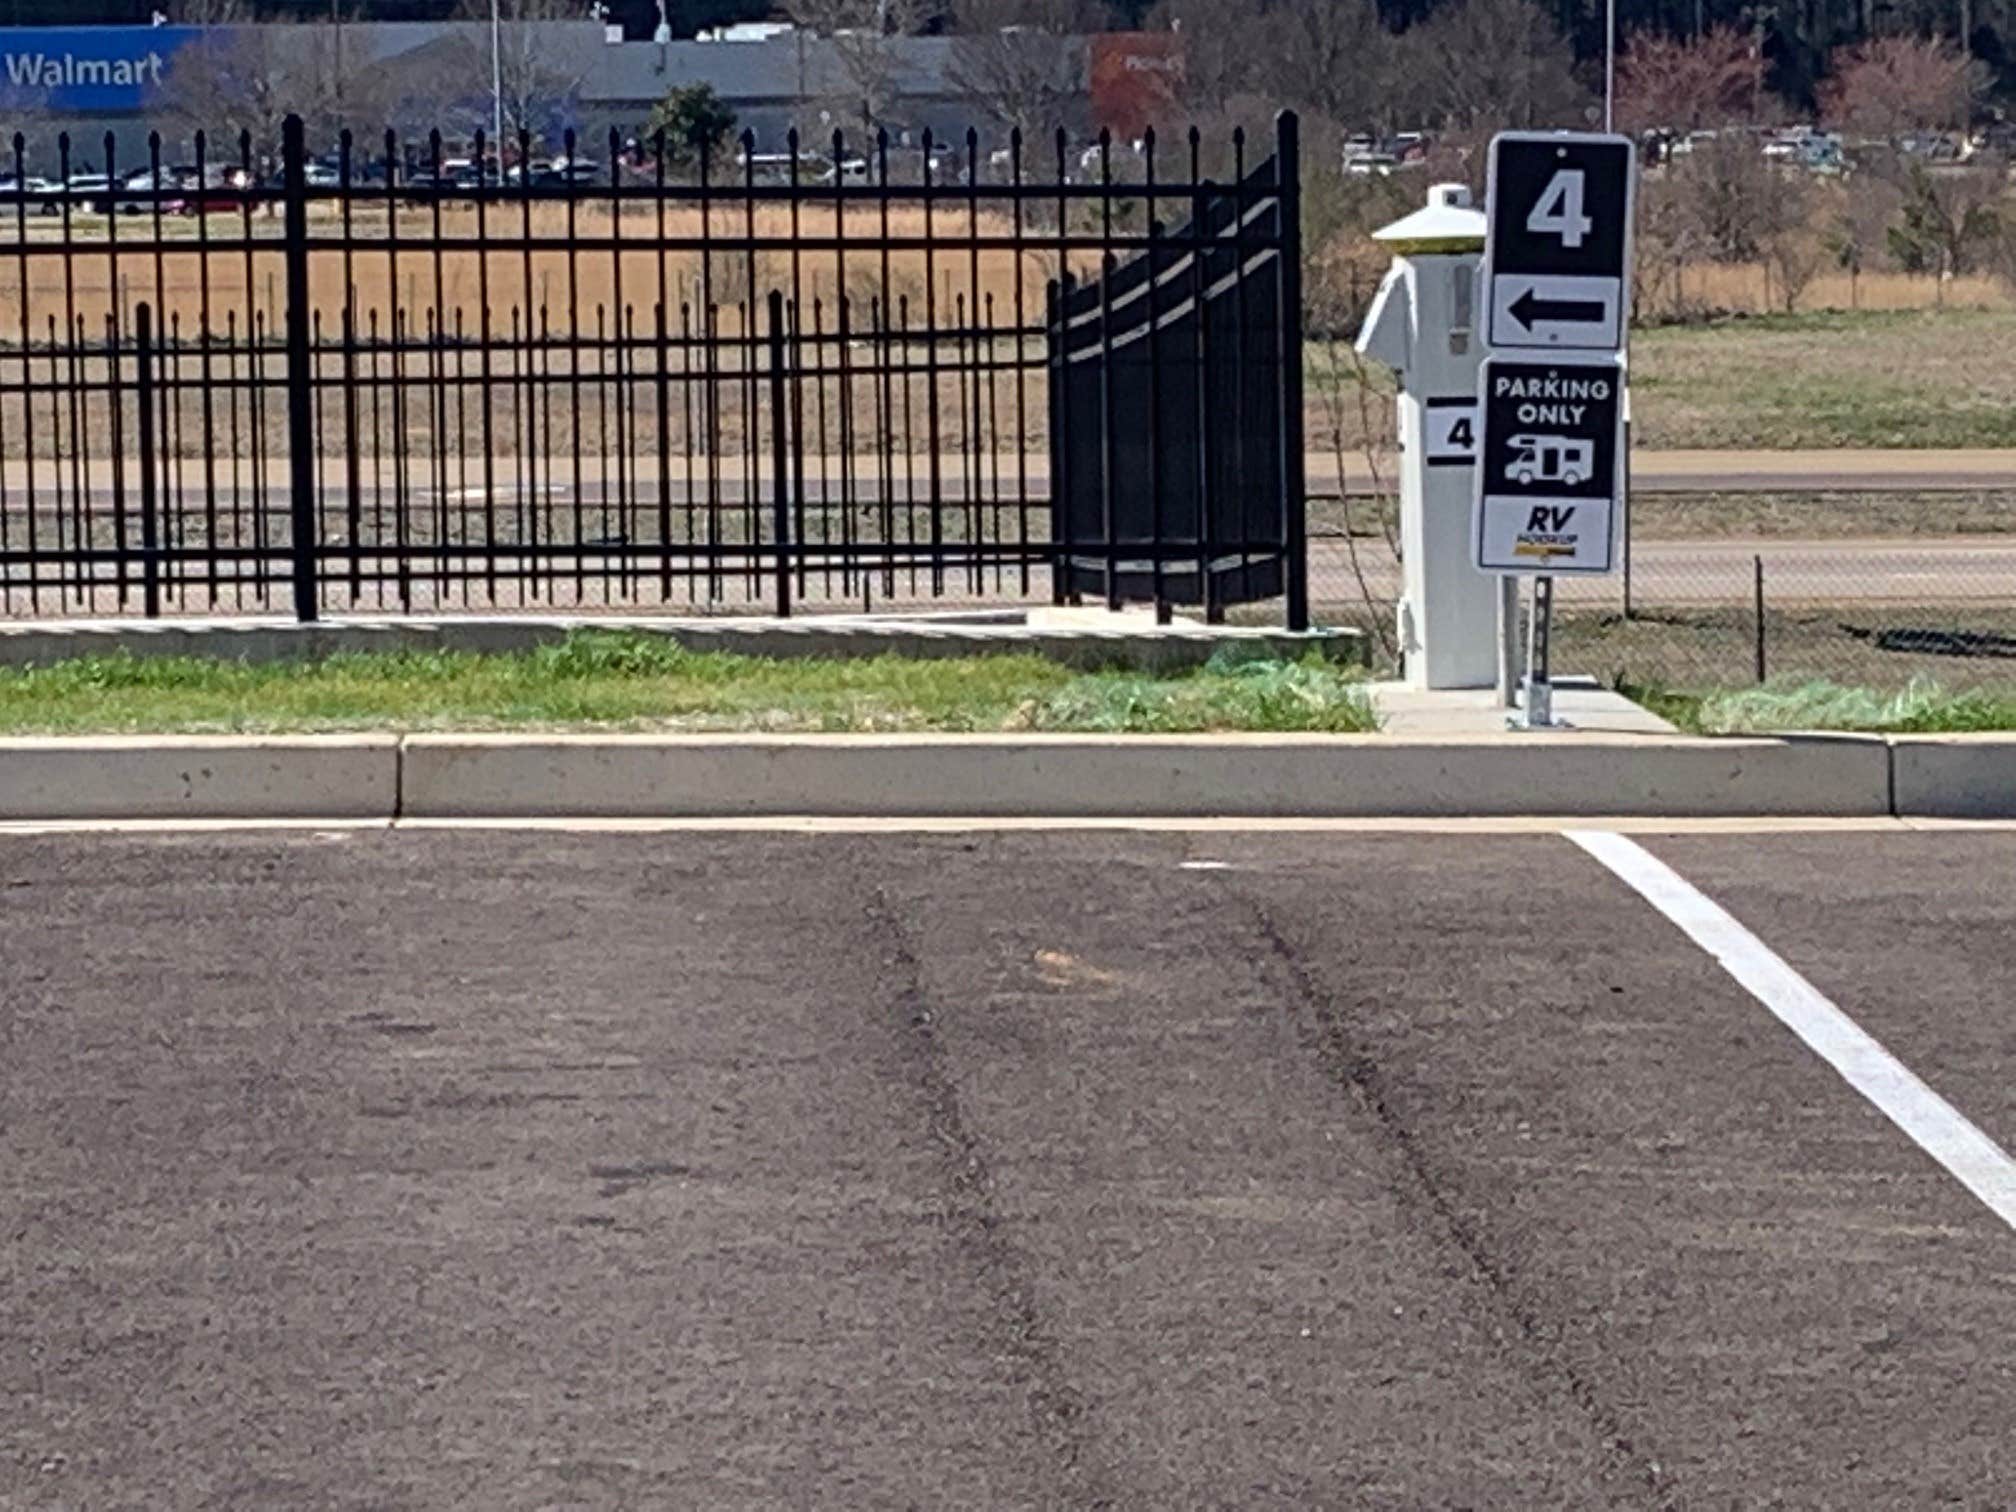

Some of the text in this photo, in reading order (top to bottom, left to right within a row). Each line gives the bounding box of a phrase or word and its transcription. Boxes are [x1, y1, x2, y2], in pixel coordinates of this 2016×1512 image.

[6, 52, 164, 87] Walmart
[1526, 169, 1593, 248] 4
[1494, 377, 1610, 400] PARKING
[1517, 403, 1587, 425] ONLY
[1447, 417, 1474, 450] 4
[1527, 506, 1576, 533] RV
